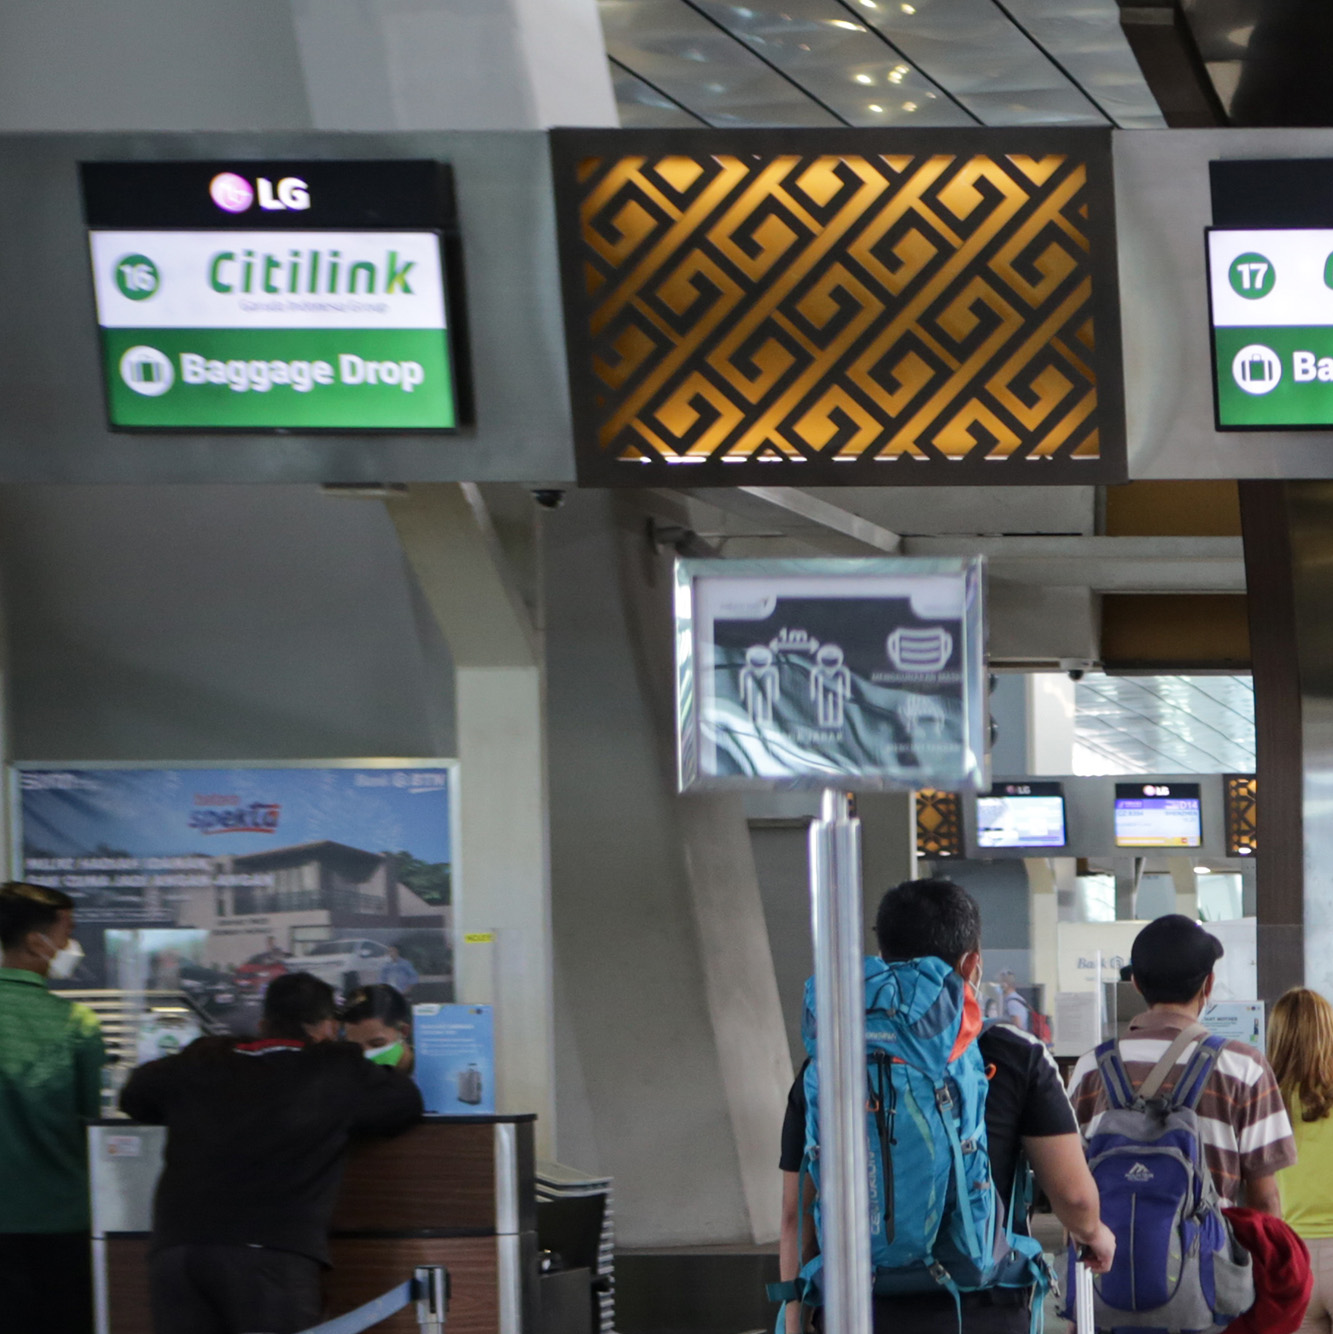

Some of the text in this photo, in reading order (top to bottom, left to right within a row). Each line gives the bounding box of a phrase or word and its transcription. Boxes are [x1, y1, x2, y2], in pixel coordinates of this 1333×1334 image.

[257, 177, 311, 210] LG
[119, 250, 416, 295] 16 Citilink
[1237, 262, 1268, 289] 17
[179, 353, 424, 392] Baggage Drop
[779, 627, 808, 642] 1m
[1077, 957, 1106, 969] Bak
